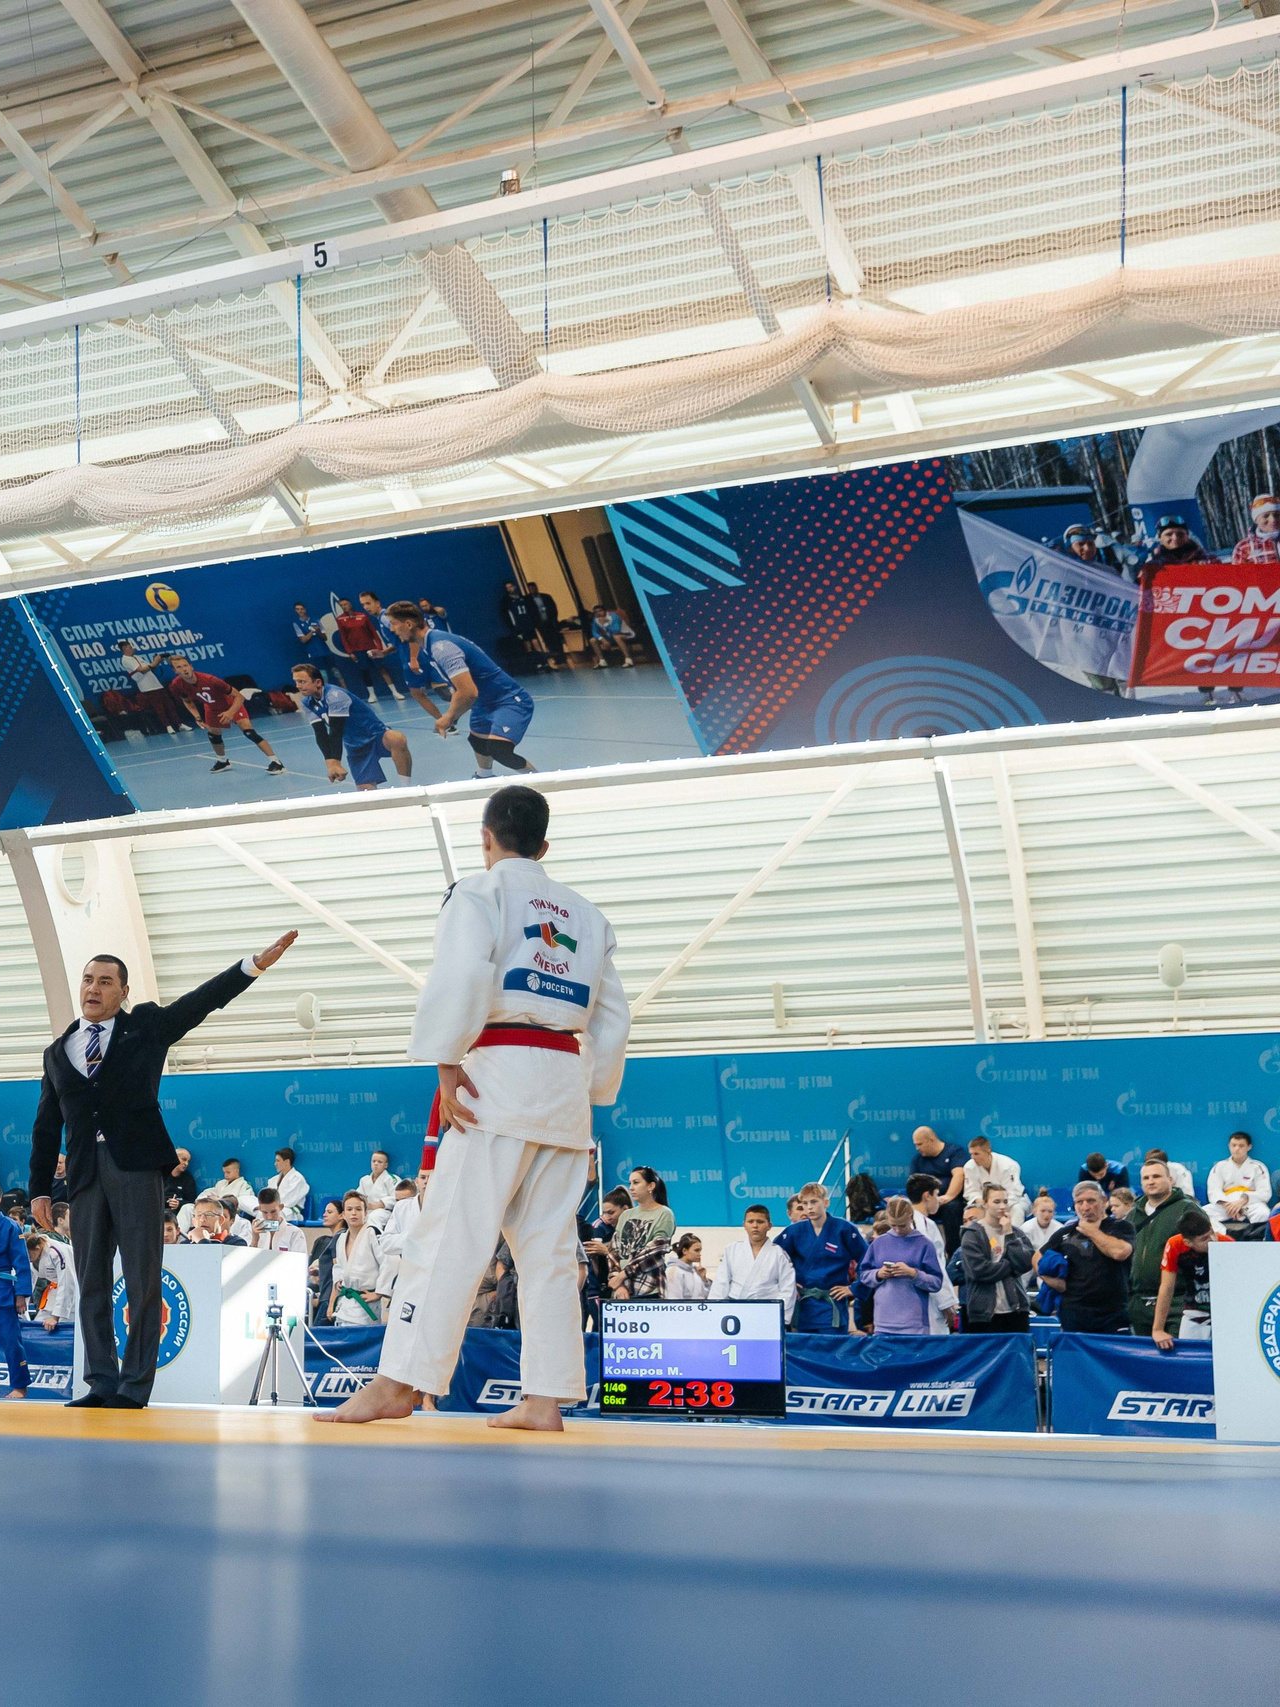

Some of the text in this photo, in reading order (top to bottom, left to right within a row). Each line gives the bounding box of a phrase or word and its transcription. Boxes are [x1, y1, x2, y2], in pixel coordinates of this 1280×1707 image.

[314, 241, 327, 268] 5
[1035, 579, 1139, 620] ГАЗПРОМ
[60, 613, 181, 642] СПАРТАКИАДА
[70, 643, 106, 660] ПАО
[1184, 652, 1280, 675] СИБ
[89, 676, 132, 694] 2022
[196, 691, 215, 703] 12
[533, 951, 570, 975] ENERGY
[541, 981, 574, 996] РОССЕТИ
[605, 1302, 712, 1313] Стрельников Ф.
[175, 1292, 188, 1347] РОССИИ
[604, 1317, 650, 1333] Ново
[721, 1315, 741, 1336] 0
[604, 1343, 662, 1363] КрасЯ
[721, 1344, 738, 1366] 1
[605, 1366, 683, 1377] Комаров М.
[603, 1383, 627, 1392] 1/4Ф
[648, 1380, 734, 1408] 2:38
[909, 1381, 975, 1389] www.start-line.ru
[603, 1395, 627, 1405] 66кг
[786, 1391, 967, 1412] START LINE
[1118, 1397, 1213, 1418] STAR
